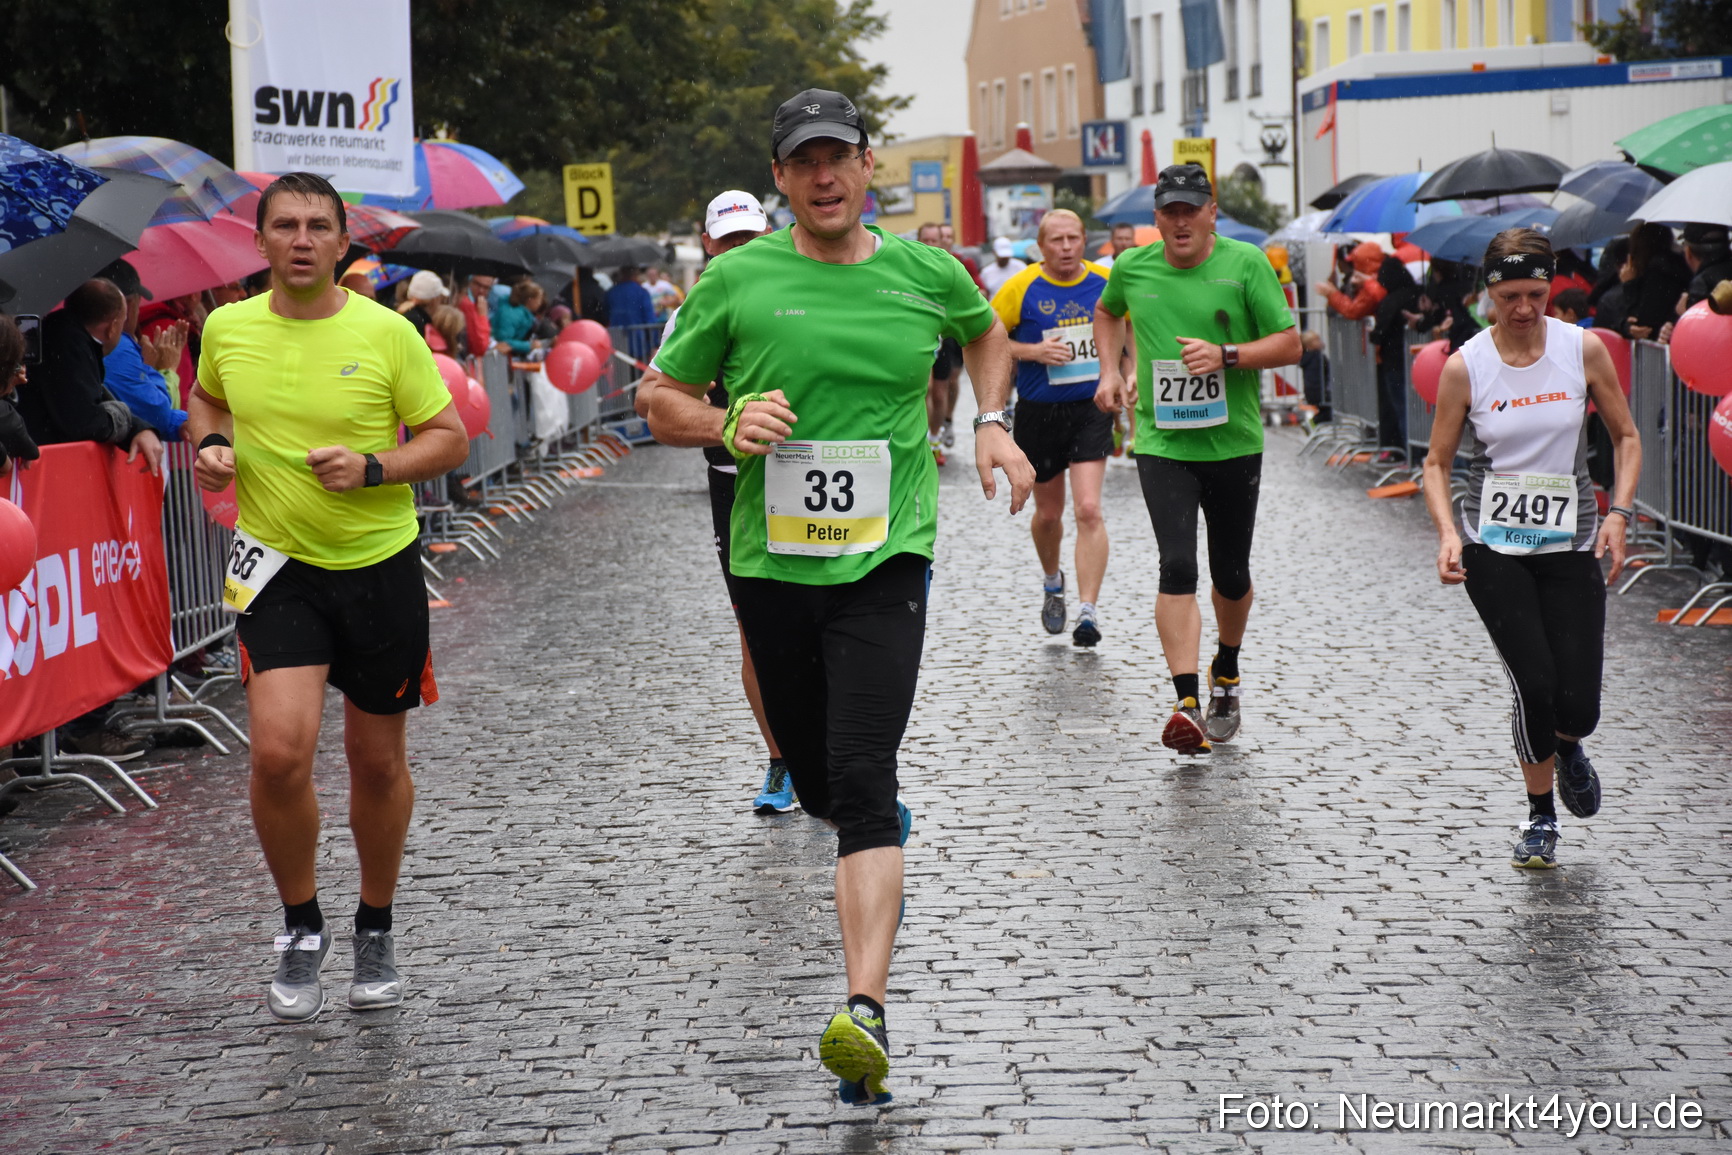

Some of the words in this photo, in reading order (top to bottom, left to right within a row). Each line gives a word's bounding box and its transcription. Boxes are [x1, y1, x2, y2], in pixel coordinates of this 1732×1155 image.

[254, 84, 355, 129] swn
[252, 129, 326, 147] stadtwerke
[330, 135, 386, 151] neumarkt
[1178, 141, 1212, 154] Block
[287, 154, 302, 165] wir
[304, 153, 340, 167] bieten
[569, 167, 604, 181] Block
[577, 186, 602, 220] D
[1159, 373, 1220, 402] 2726
[1511, 391, 1572, 408] KLEBL
[1173, 407, 1209, 419] Helmut
[775, 453, 815, 461] NeuerMarkt
[822, 445, 880, 459] BOCK
[1526, 475, 1571, 488] BOCK
[804, 469, 854, 513] 33
[770, 505, 776, 514] C
[1490, 491, 1570, 526] 2497
[807, 523, 850, 541] Peter
[1505, 531, 1548, 546] Kerstin
